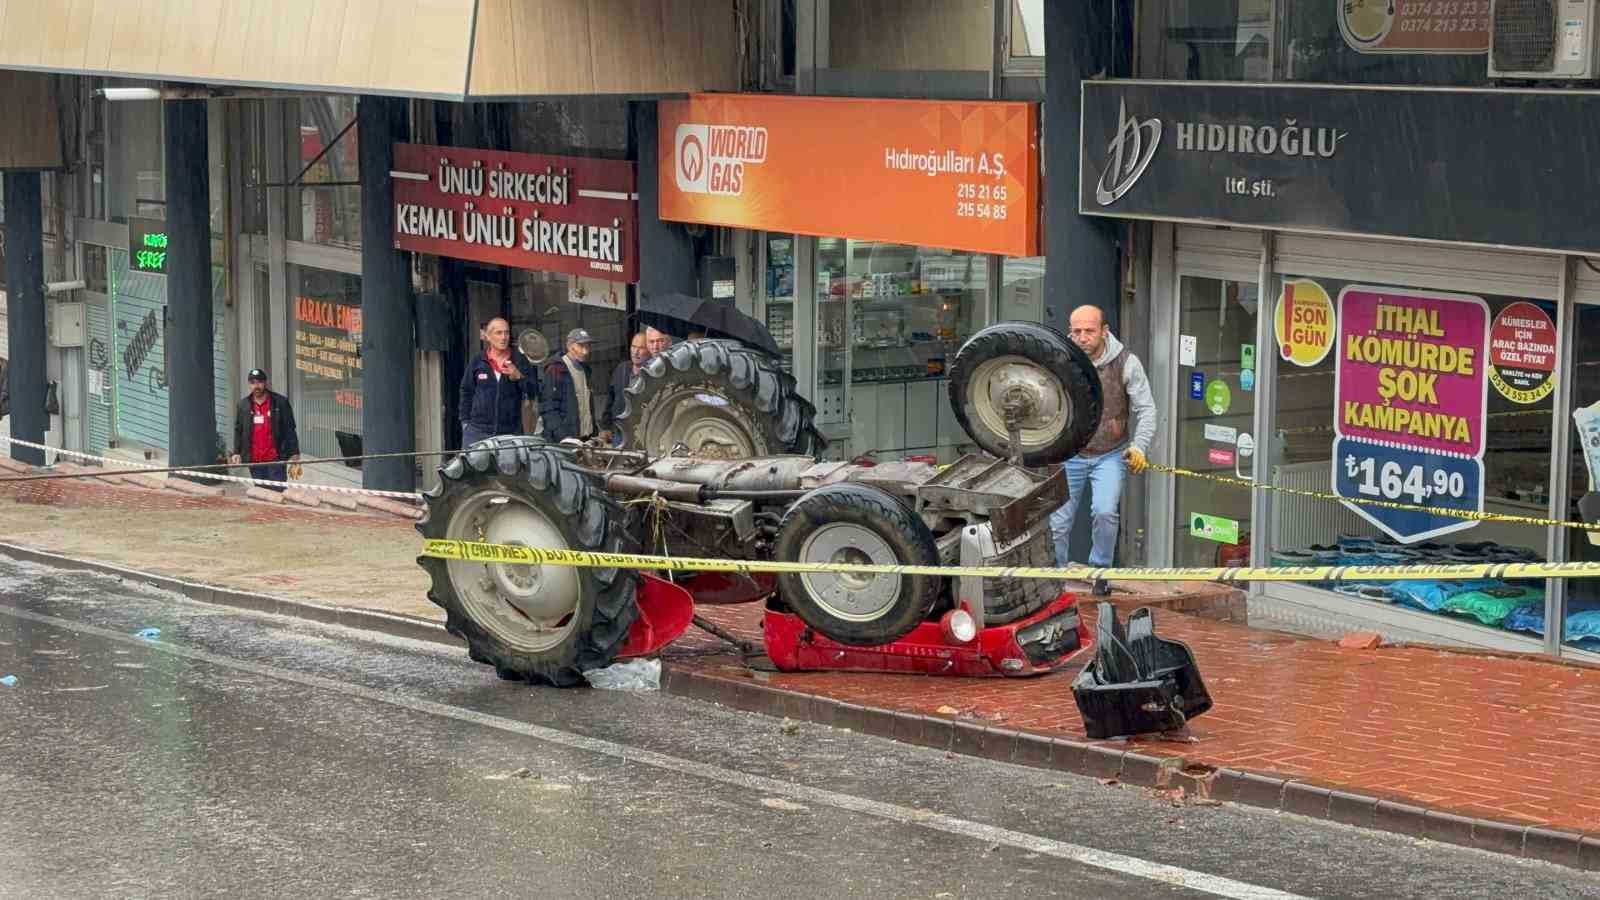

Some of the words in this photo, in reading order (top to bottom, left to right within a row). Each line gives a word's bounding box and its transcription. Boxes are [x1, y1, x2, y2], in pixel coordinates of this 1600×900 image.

[1400, 18, 1432, 33] 0374
[1433, 19, 1458, 33] 213
[1460, 19, 1479, 33] 23
[709, 127, 766, 160] WORLD
[1176, 118, 1348, 158] HIDIROĞLU
[710, 164, 743, 193] GAS
[885, 147, 974, 176] Hıdıroğulları
[977, 154, 1007, 180] A.Ş.
[438, 158, 484, 196] ÜNLÜ
[489, 162, 568, 205] SİRKECİSİ
[958, 184, 976, 198] 215
[977, 185, 990, 199] 21
[993, 186, 1007, 200] 65
[957, 202, 975, 216] 215
[977, 203, 991, 217] 54
[993, 205, 1007, 219] 85
[397, 203, 458, 240] KEMAL
[463, 202, 515, 249] ÜNLÜ
[522, 209, 622, 262] SİRKELERİ
[1293, 306, 1328, 326] SON
[1375, 298, 1445, 337] İTHAL
[1502, 316, 1548, 330] KÜMESLER
[1292, 325, 1326, 347] GÜN
[1346, 329, 1475, 376] KÖMÜRDE
[1492, 340, 1517, 351] ARAÇ
[1517, 341, 1555, 354] BAZINDA
[1500, 349, 1522, 362] ÖZEL
[1523, 352, 1547, 365] FİYAT
[1377, 367, 1439, 406] ŞOK
[1344, 400, 1472, 444] KAMPANYA
[1344, 453, 1465, 504] ₺164,90
